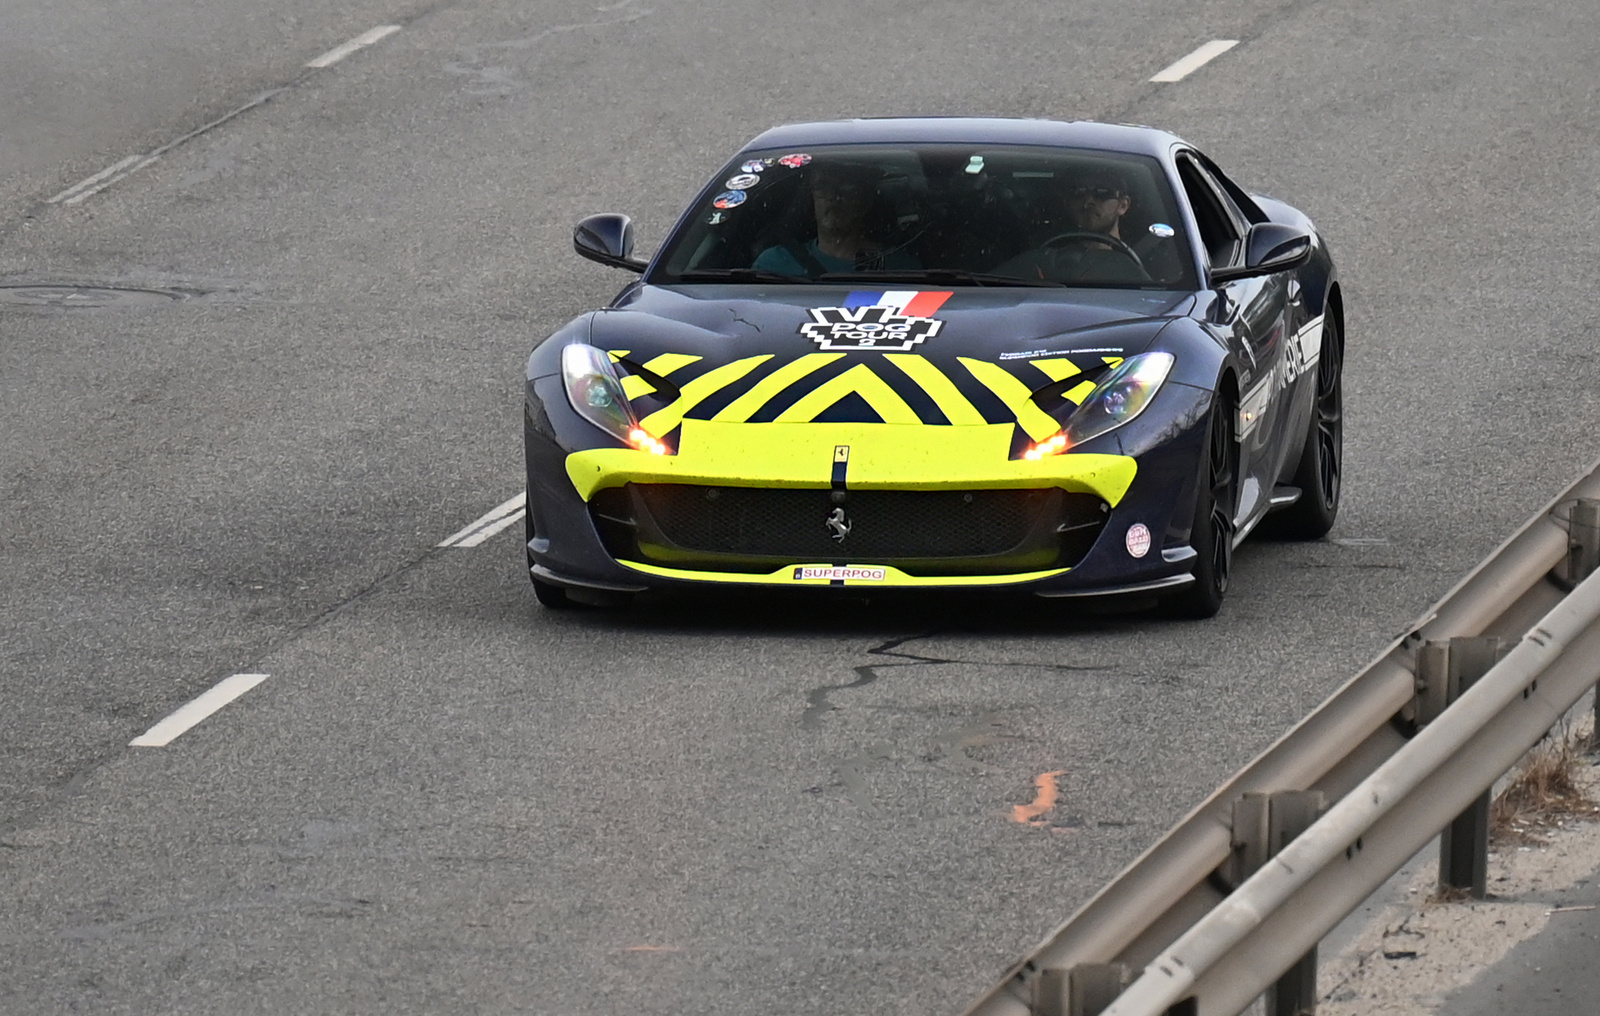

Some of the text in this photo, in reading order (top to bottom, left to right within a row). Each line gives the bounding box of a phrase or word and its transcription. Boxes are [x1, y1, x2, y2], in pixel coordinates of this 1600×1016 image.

[832, 323, 911, 332] POG
[830, 331, 908, 340] TOUR
[858, 339, 876, 347] 2
[804, 569, 882, 579] SUPERPOG
